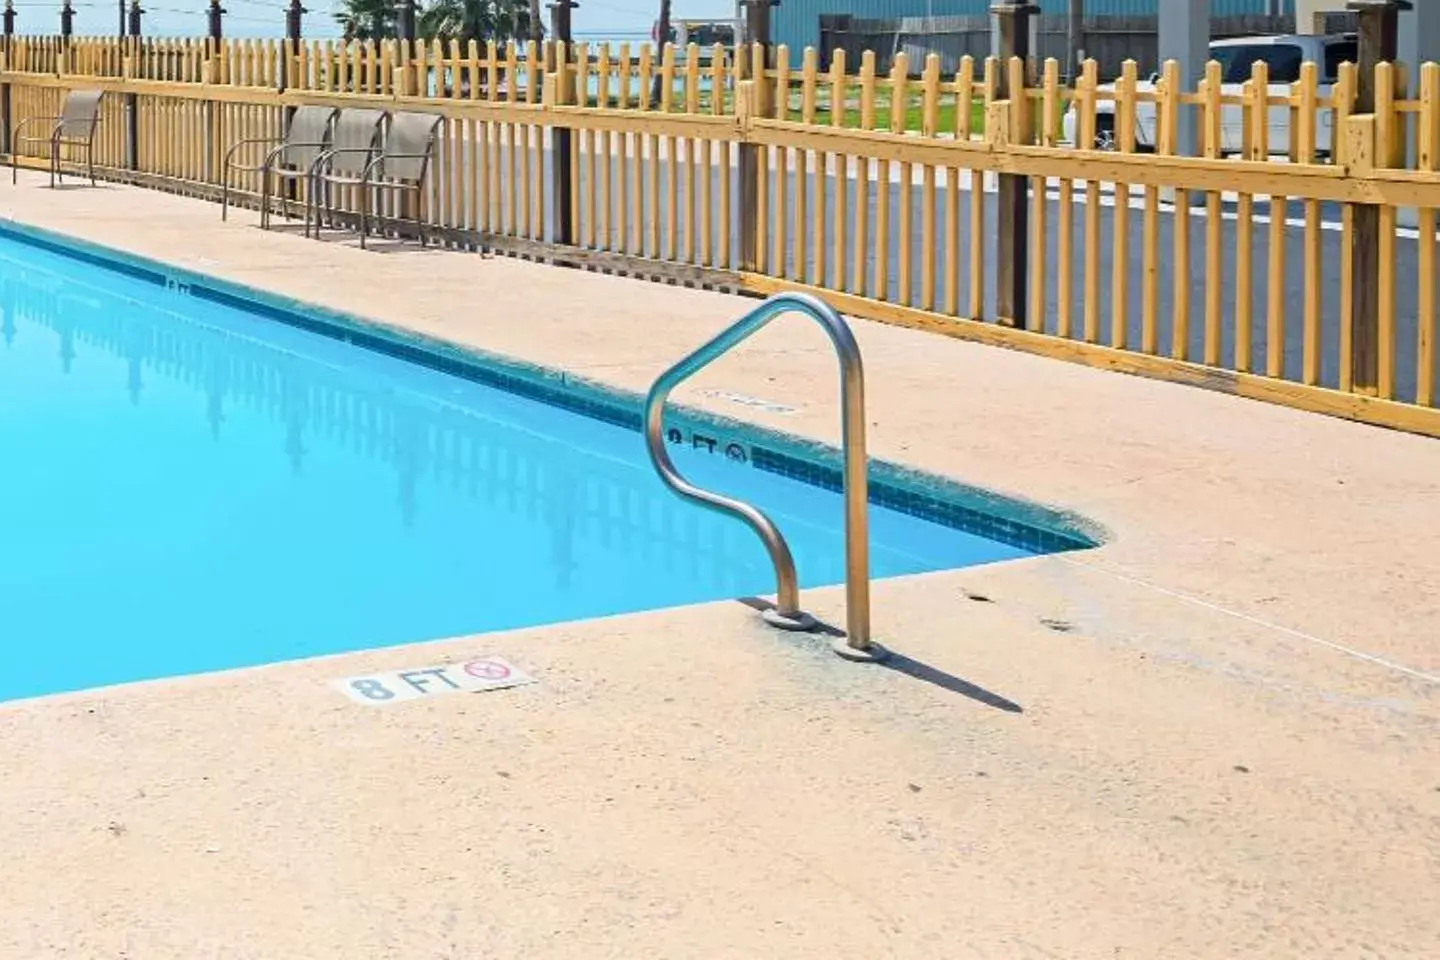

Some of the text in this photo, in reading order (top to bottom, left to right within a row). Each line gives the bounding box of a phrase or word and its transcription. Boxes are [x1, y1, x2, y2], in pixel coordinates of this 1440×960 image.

[692, 434, 717, 454] FT
[350, 668, 460, 701] 8 FT
